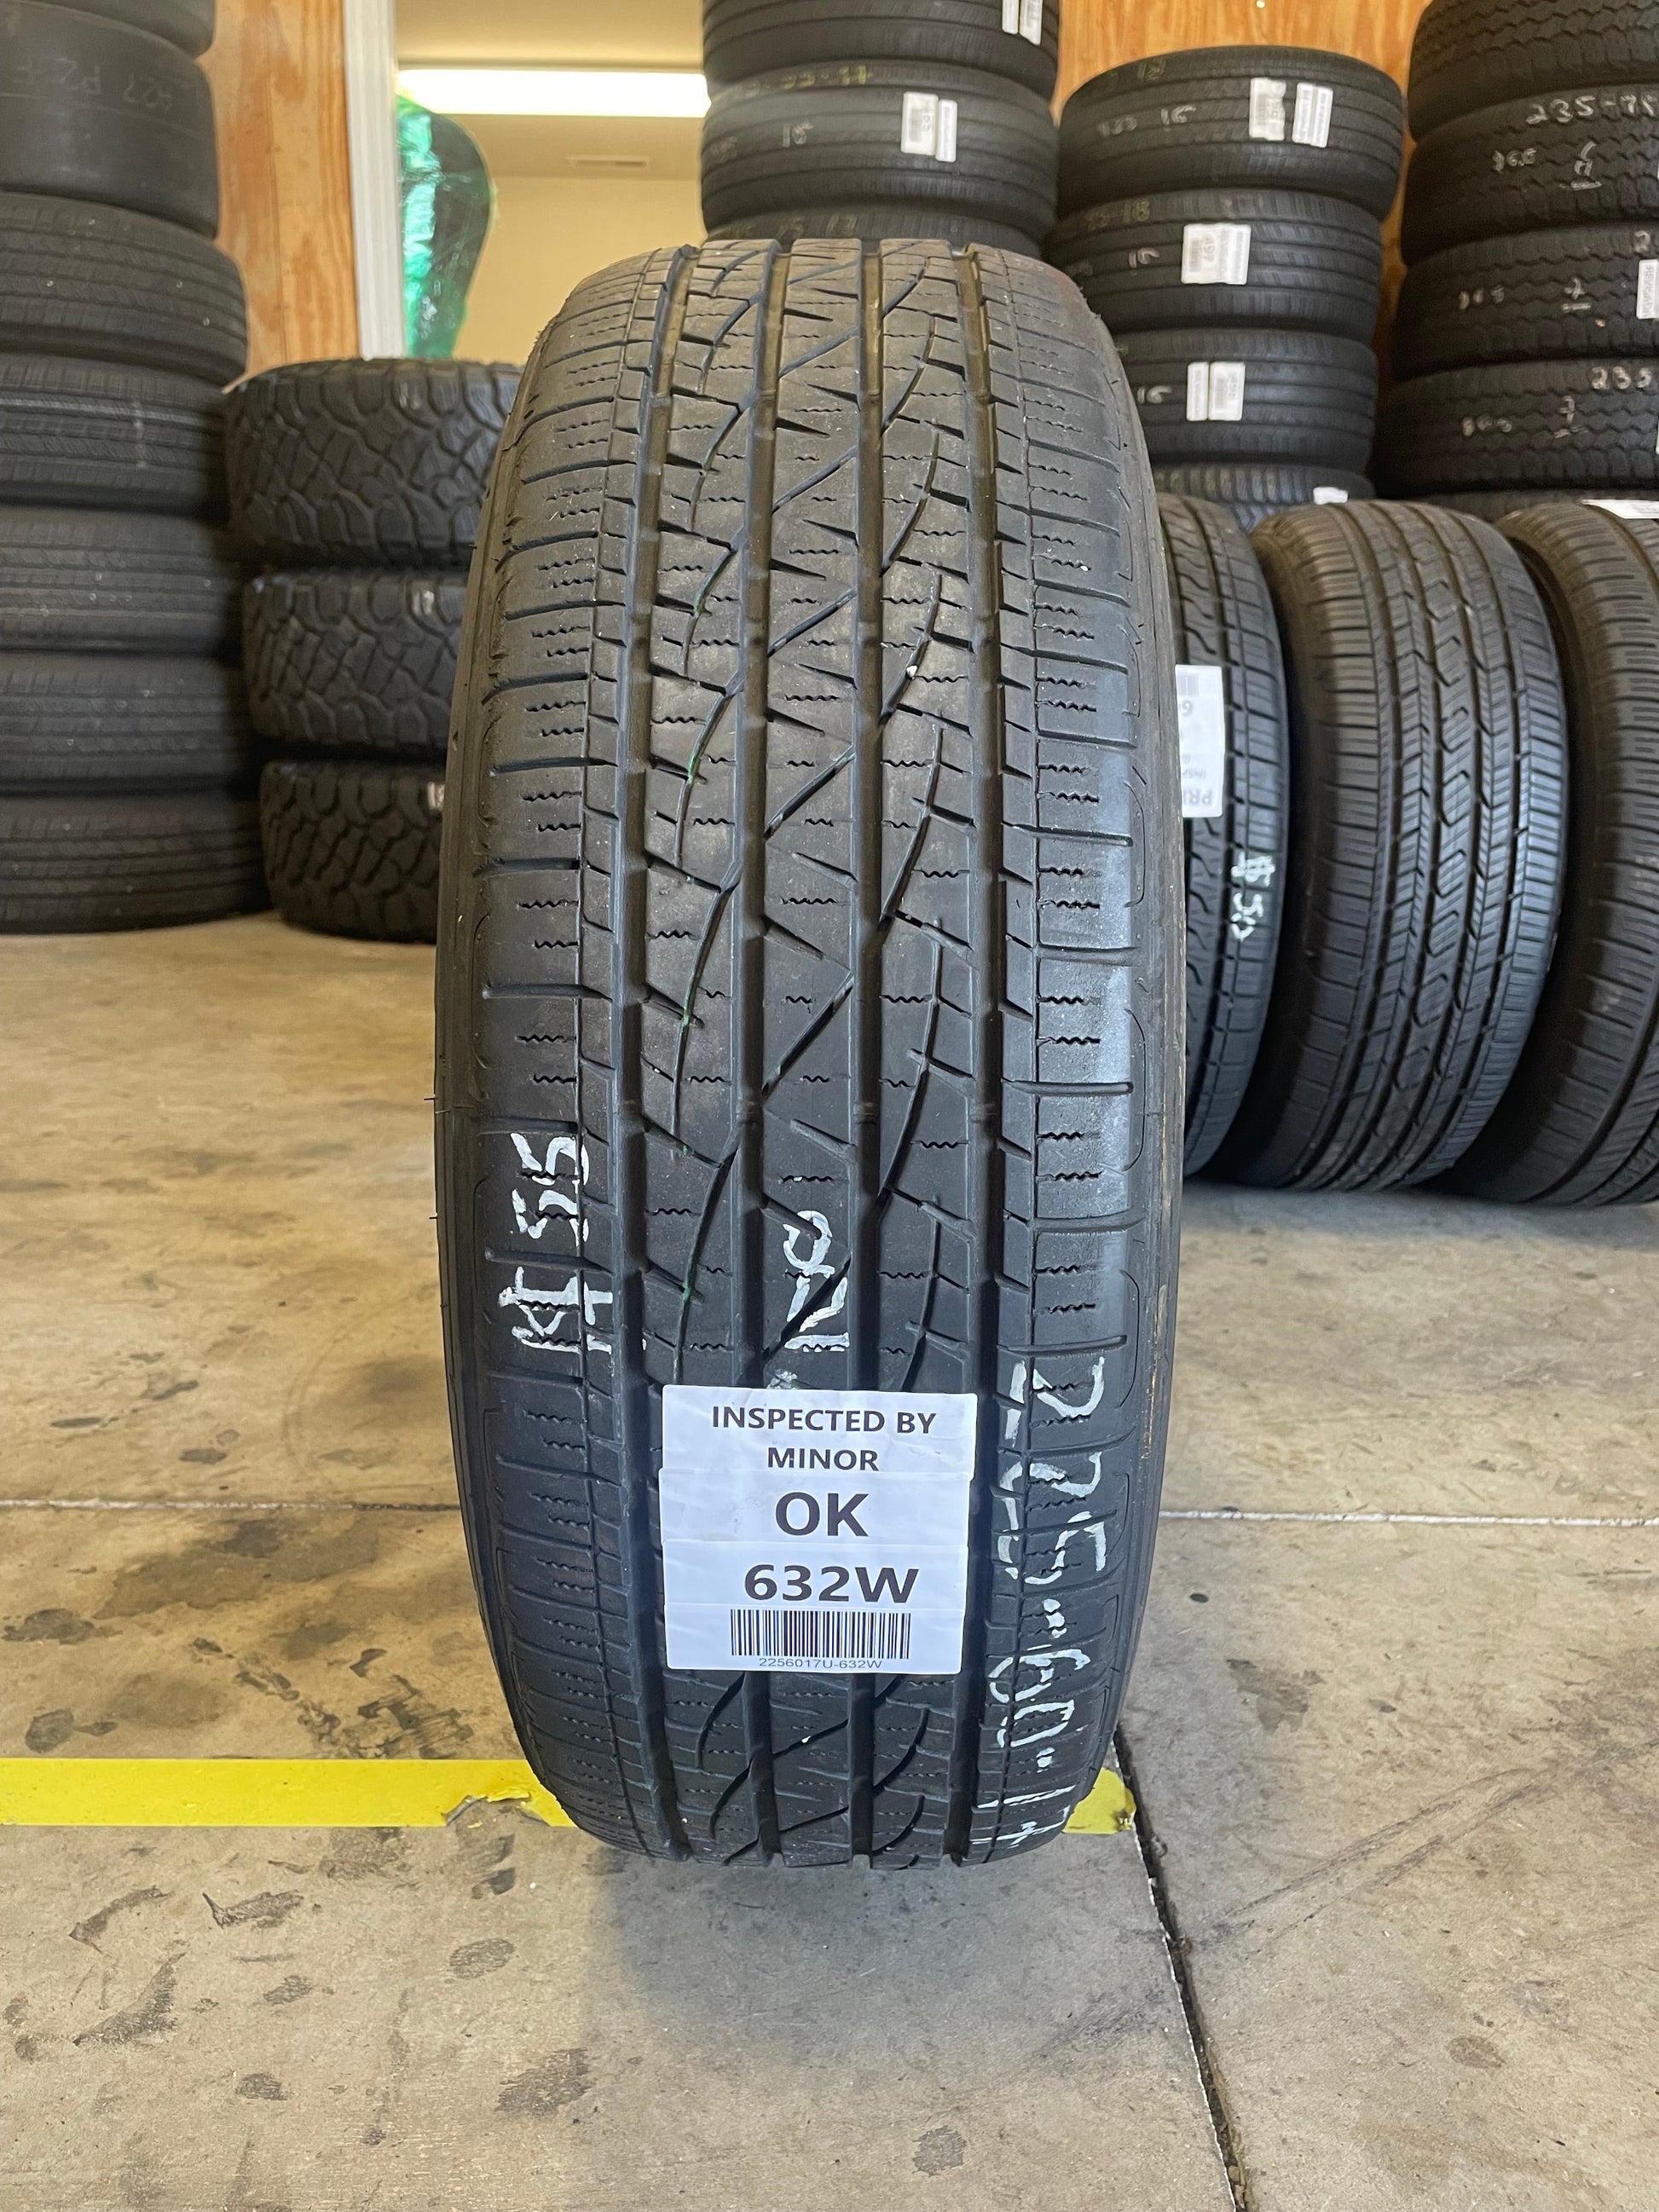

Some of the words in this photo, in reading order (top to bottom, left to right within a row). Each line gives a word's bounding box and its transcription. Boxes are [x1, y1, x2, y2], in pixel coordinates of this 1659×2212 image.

[712, 1406, 885, 1432] INSPECTED
[896, 1412, 936, 1434] BY
[767, 1447, 880, 1471] MINOR
[775, 1492, 869, 1537] OK
[744, 1563, 919, 1603] 632W
[759, 1657, 882, 1669] 2256017U-632W
